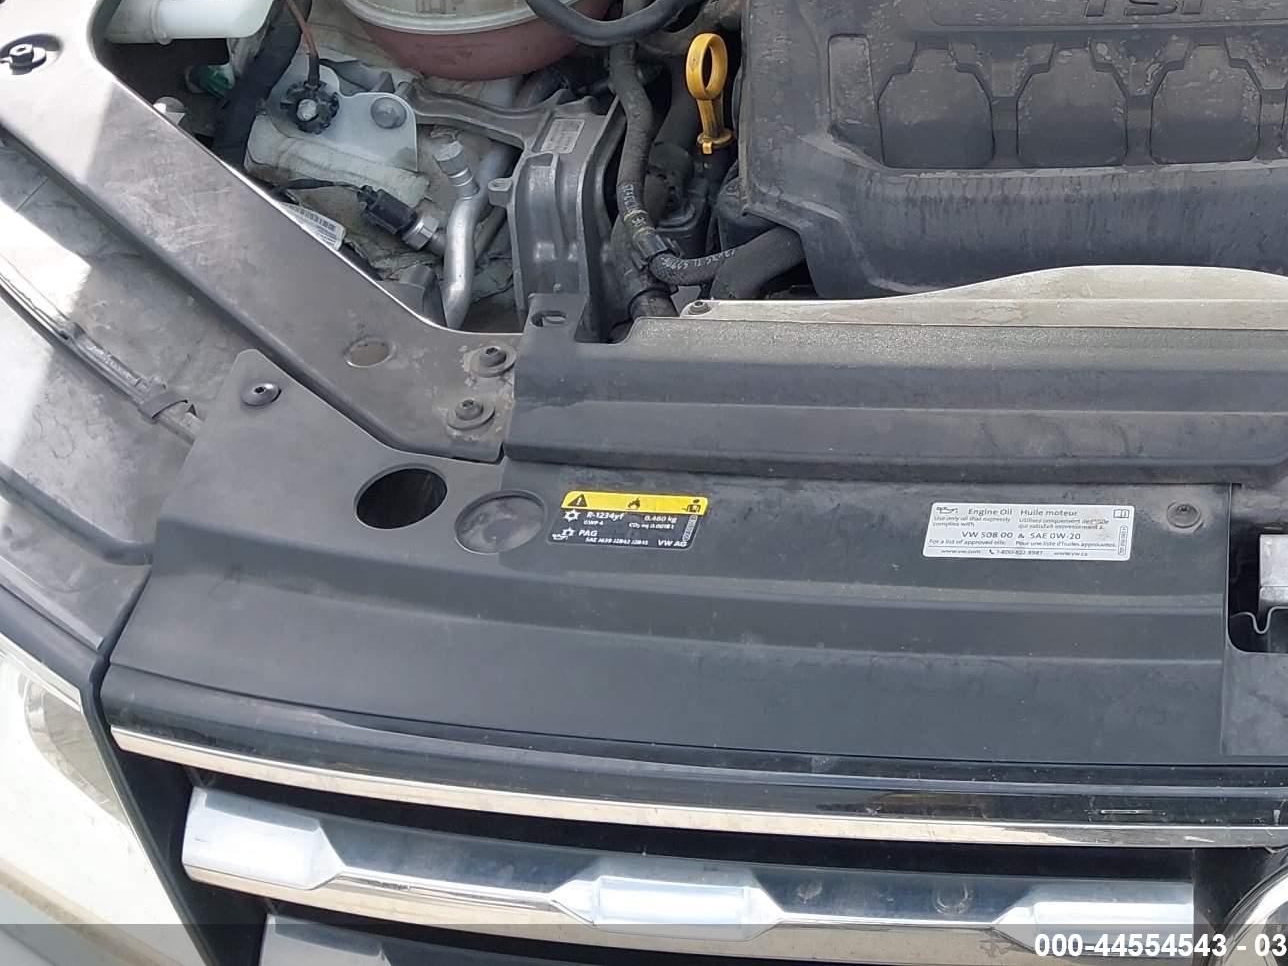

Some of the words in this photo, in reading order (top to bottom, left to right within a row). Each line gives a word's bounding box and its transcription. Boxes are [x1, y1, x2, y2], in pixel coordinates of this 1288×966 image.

[586, 511, 625, 521] R-1234yf
[968, 508, 999, 516] Engine
[578, 529, 598, 537] PAG
[961, 530, 979, 538] VW
[1030, 532, 1048, 540] SAE
